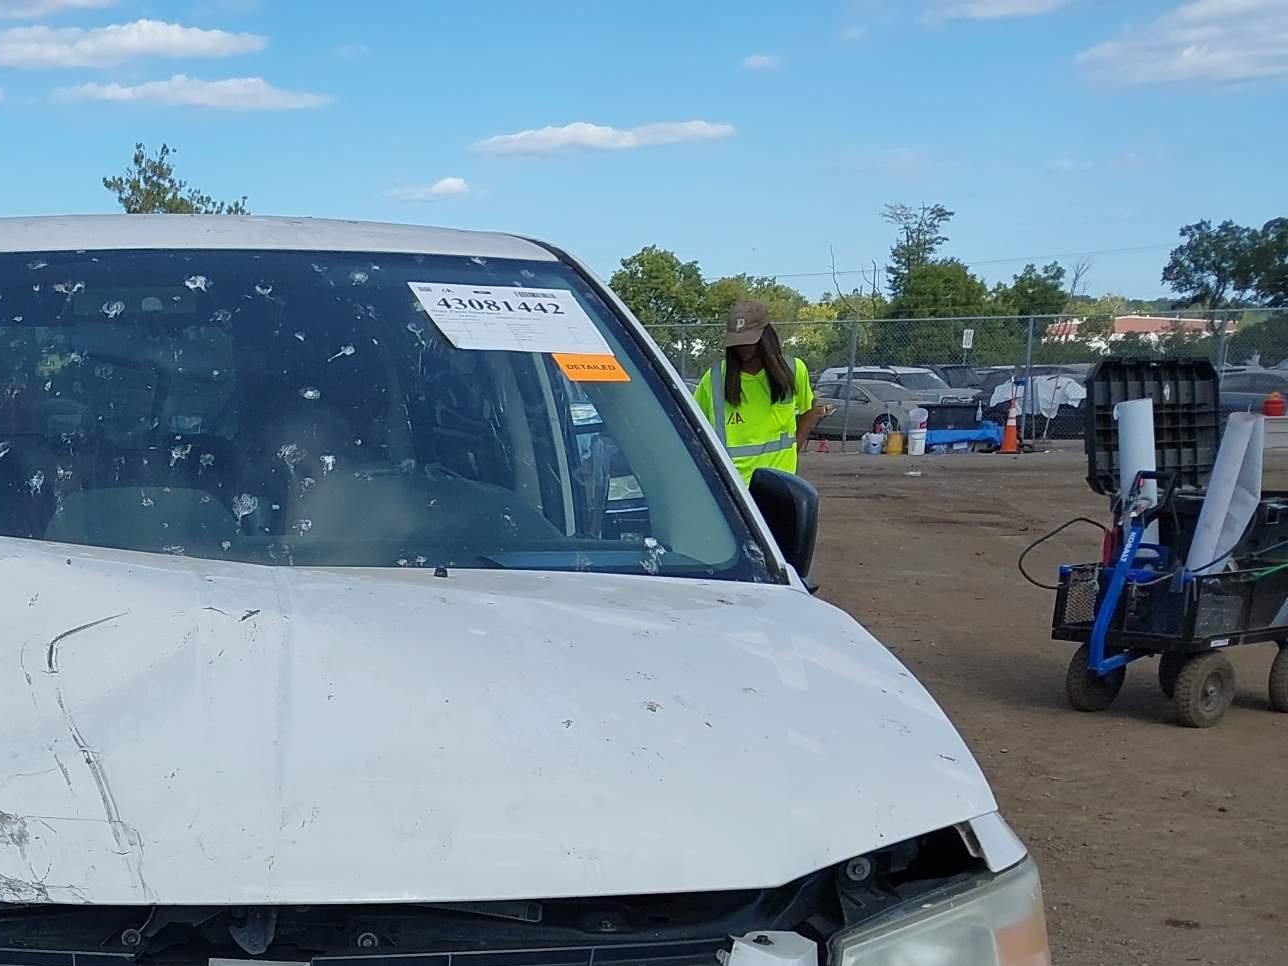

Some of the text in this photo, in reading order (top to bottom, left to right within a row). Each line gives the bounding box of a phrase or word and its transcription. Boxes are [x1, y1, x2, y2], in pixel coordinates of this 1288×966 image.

[436, 297, 565, 315] 43081442
[566, 363, 617, 371] DETAILED
[1120, 531, 1137, 562] KOBALT
